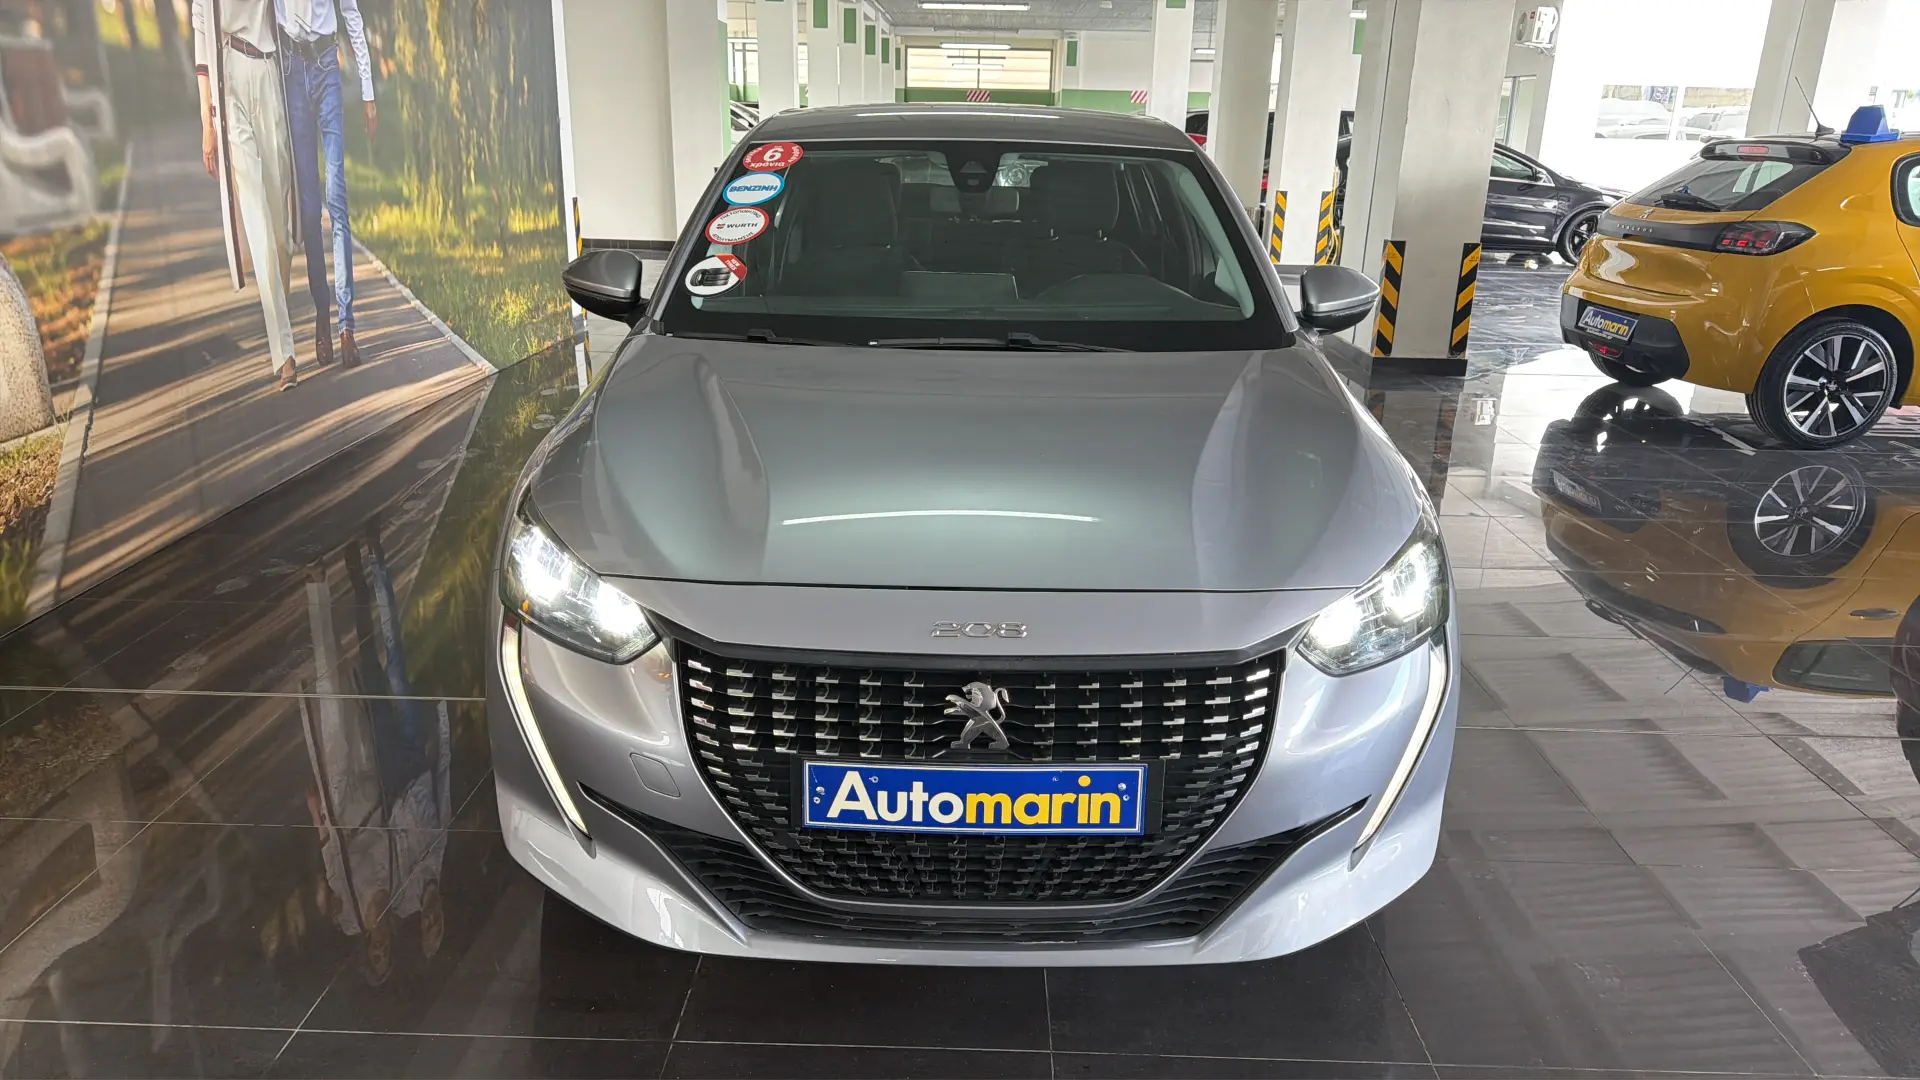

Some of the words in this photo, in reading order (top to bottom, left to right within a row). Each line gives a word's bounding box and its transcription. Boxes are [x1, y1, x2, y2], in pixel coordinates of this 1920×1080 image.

[763, 147, 784, 162] 6
[750, 161, 786, 169] χρόνια
[1583, 309, 1630, 336] Automarin
[930, 620, 1028, 638] 208
[826, 770, 1121, 826] Automarin
